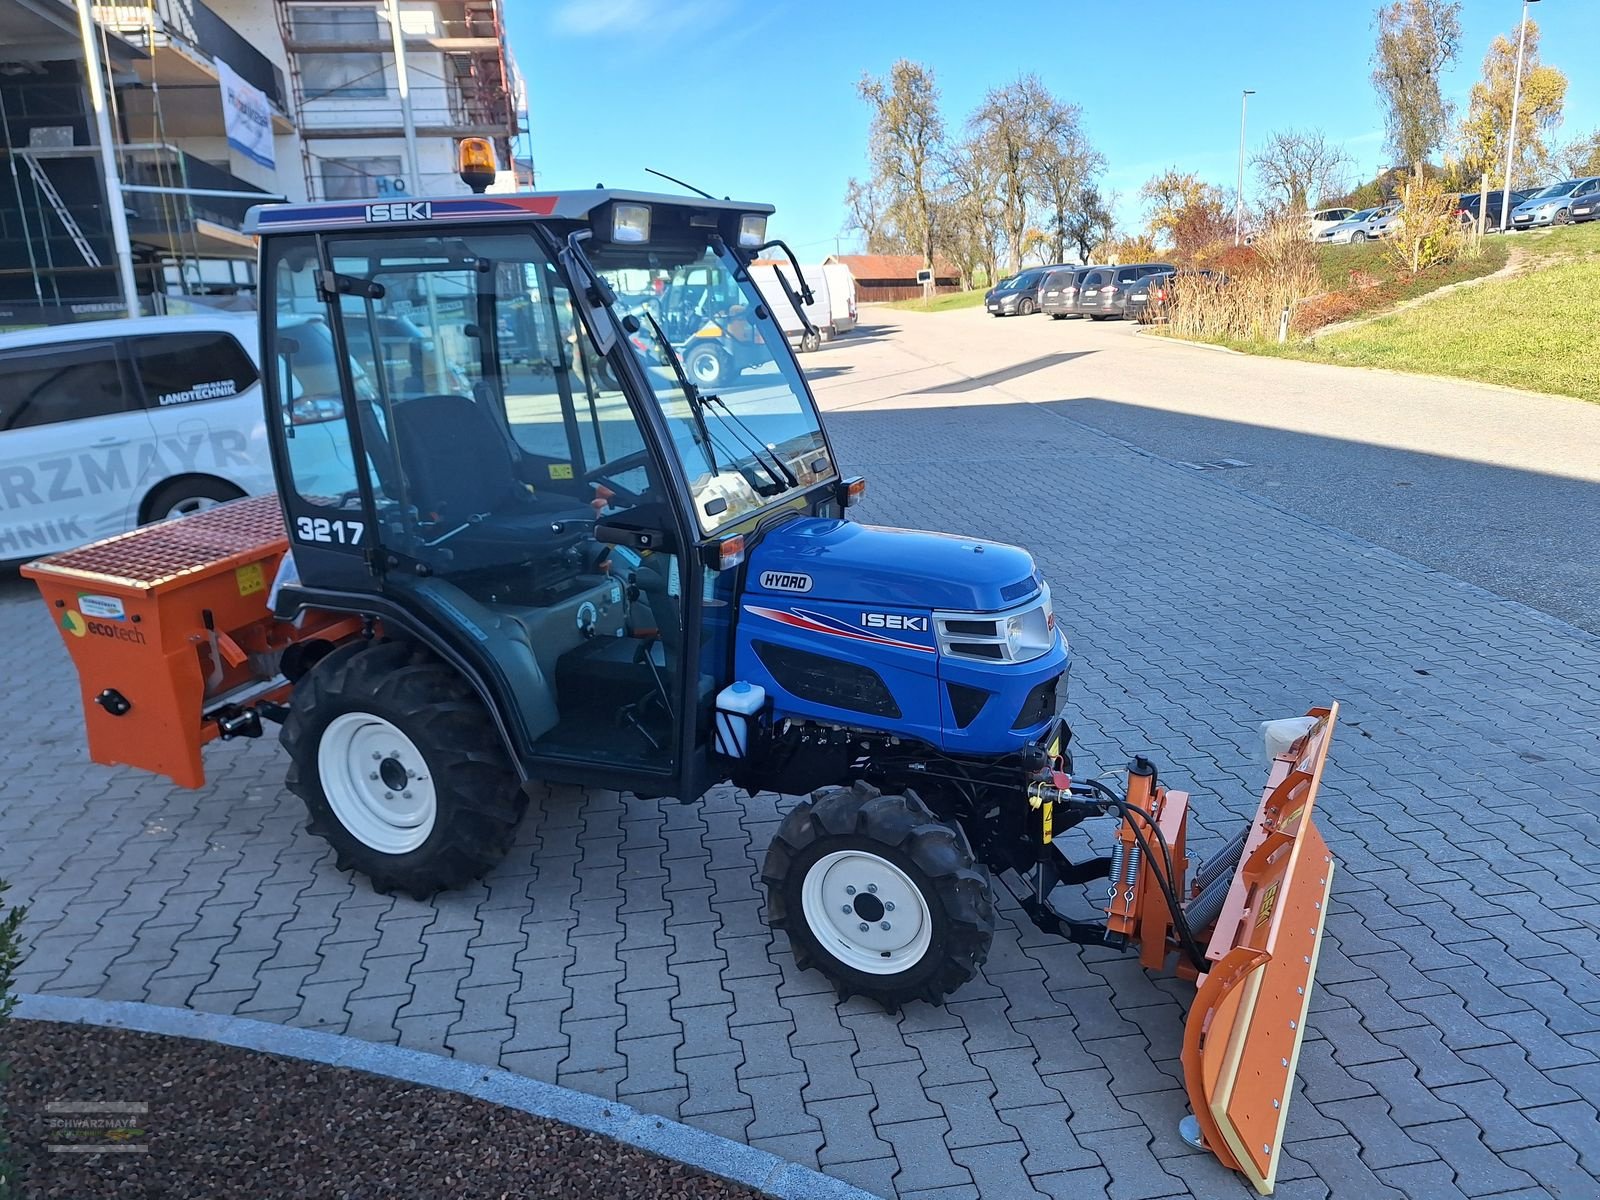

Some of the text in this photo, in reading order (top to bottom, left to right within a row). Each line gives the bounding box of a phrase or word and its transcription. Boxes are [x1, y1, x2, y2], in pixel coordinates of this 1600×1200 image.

[365, 202, 432, 222] ISEKI
[159, 385, 237, 405] LANDTECHNIK
[0, 429, 248, 511] RZMAYR
[297, 516, 364, 545] 3217
[765, 573, 807, 589] HYDRO
[861, 612, 928, 631] ISEKI
[87, 621, 146, 645] ecotech
[1256, 880, 1280, 928] ISEKI
